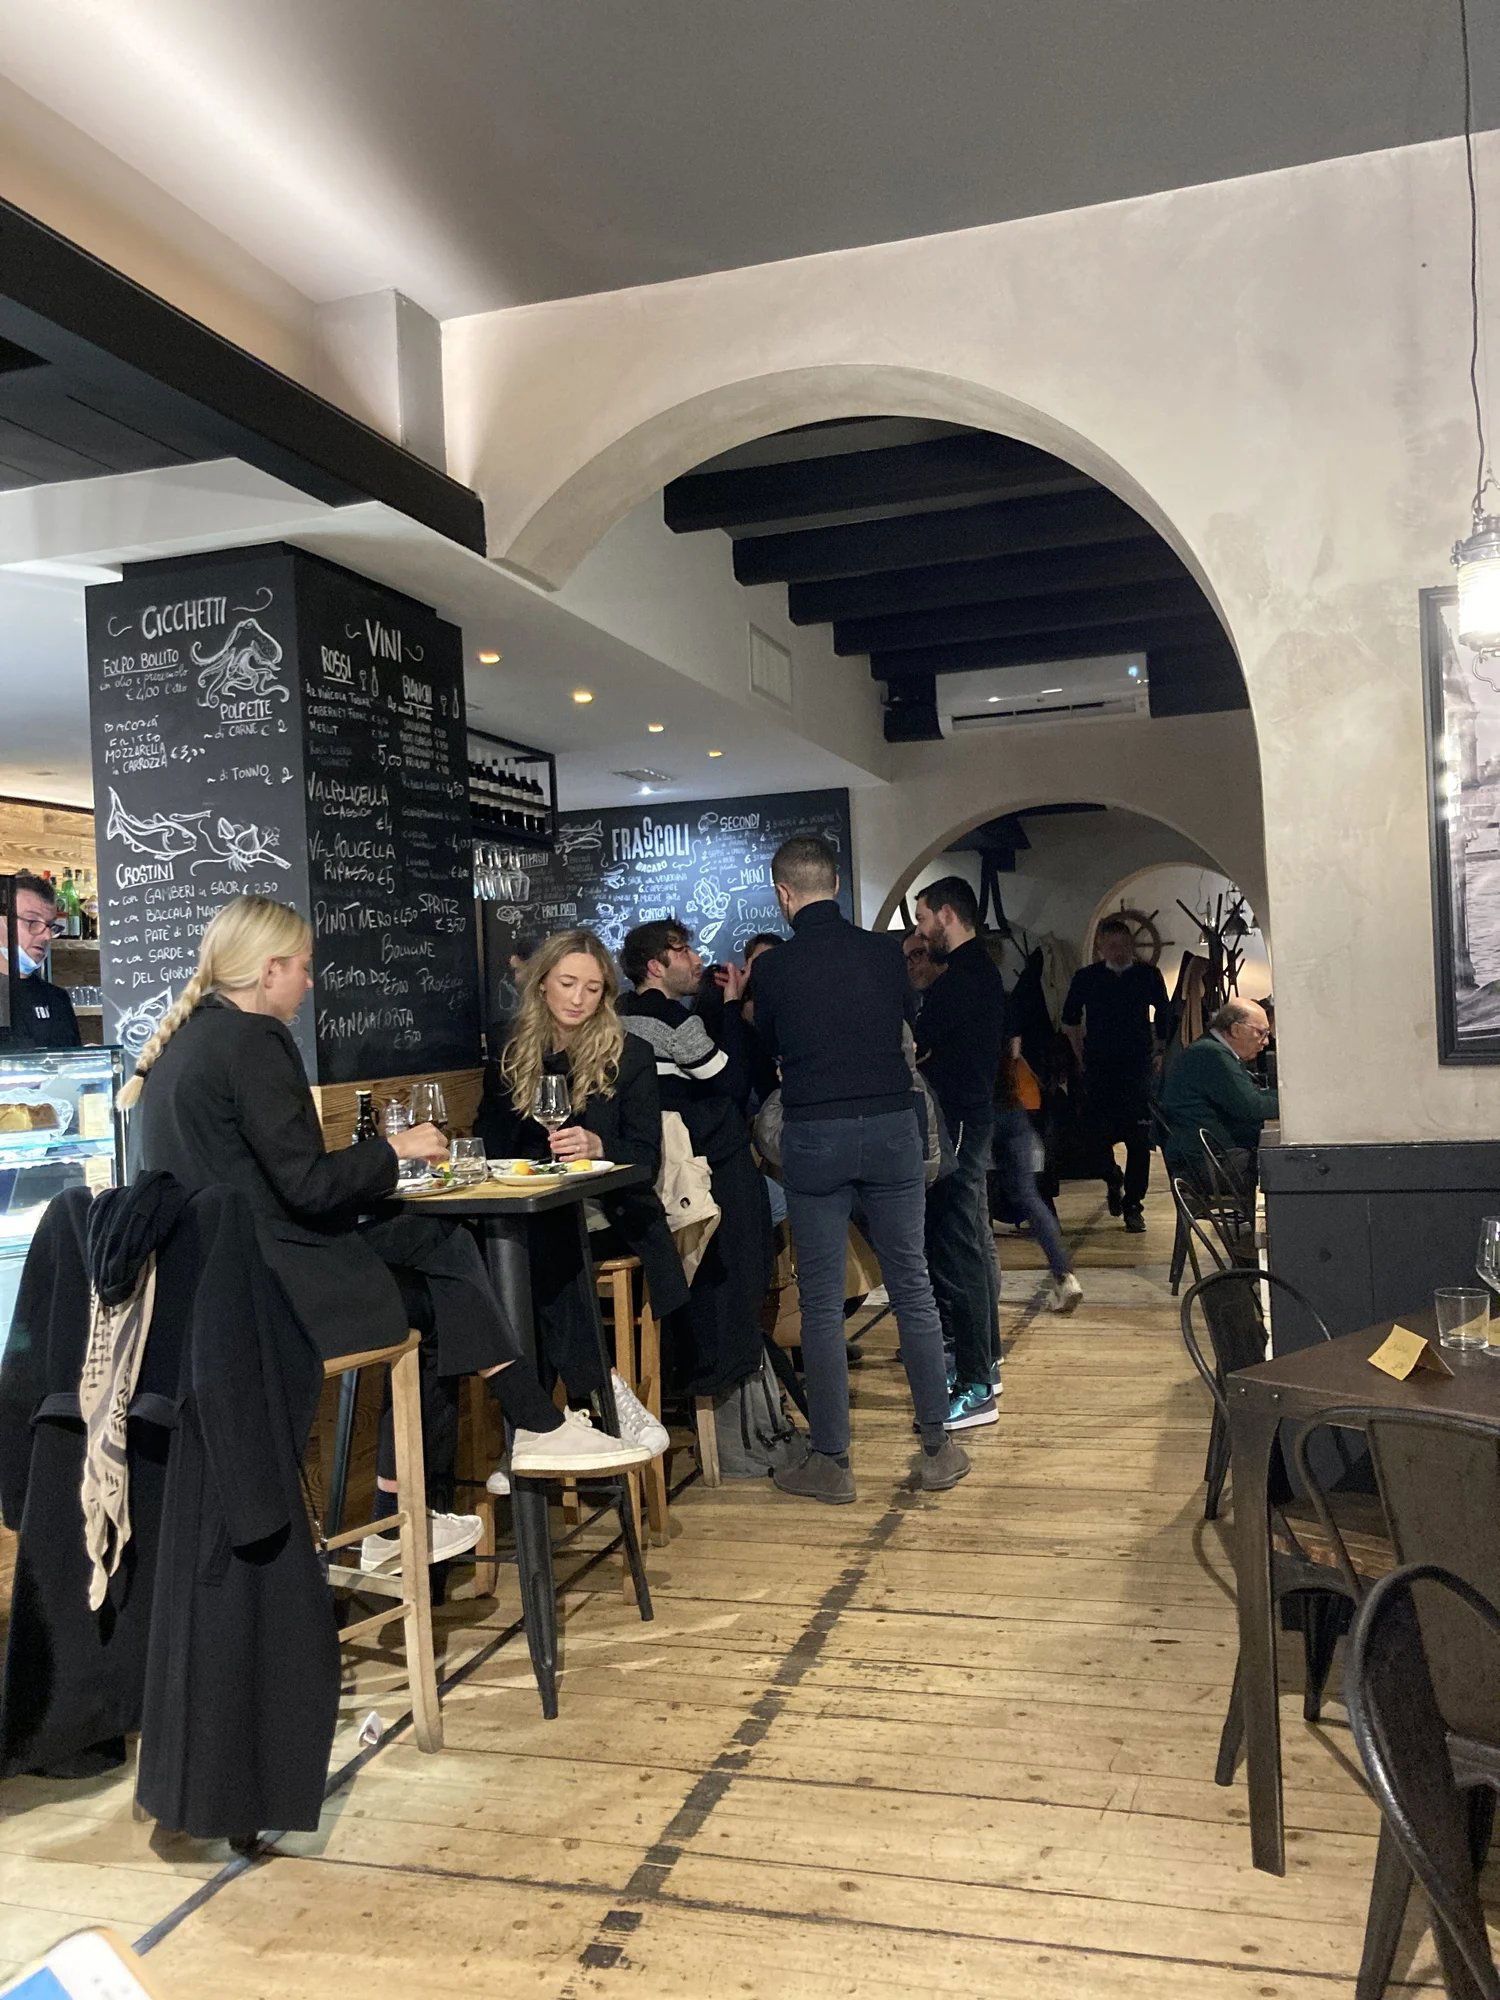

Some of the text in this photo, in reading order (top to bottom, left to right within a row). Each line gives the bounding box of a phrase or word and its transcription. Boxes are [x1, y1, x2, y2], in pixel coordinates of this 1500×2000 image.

[142, 597, 227, 639] CICCHETTI
[366, 619, 402, 662] VINI
[141, 649, 179, 668] BOLLITO
[321, 645, 352, 680] ROSSI
[221, 700, 273, 720] POLPETTE
[228, 722, 258, 737] CARNE
[277, 719, 288, 733] 2
[105, 743, 166, 764] MOZZARELLA
[122, 755, 168, 774] CARROZZA
[230, 764, 269, 780] TONNO
[281, 766, 294, 784] 2
[719, 813, 760, 831] SECONDI
[612, 816, 690, 862] FRASCOLI
[635, 860, 668, 874] BACARO
[744, 854, 752, 864] 6
[116, 862, 174, 889] CROSTINI
[324, 859, 375, 883] RIPASSO
[145, 885, 195, 904] GAMBERI
[210, 880, 240, 895] SAOR
[418, 893, 459, 915] SPRITZ
[145, 925, 171, 944] PATÈ
[149, 945, 184, 963] SARDE
[132, 971, 155, 989] DEL
